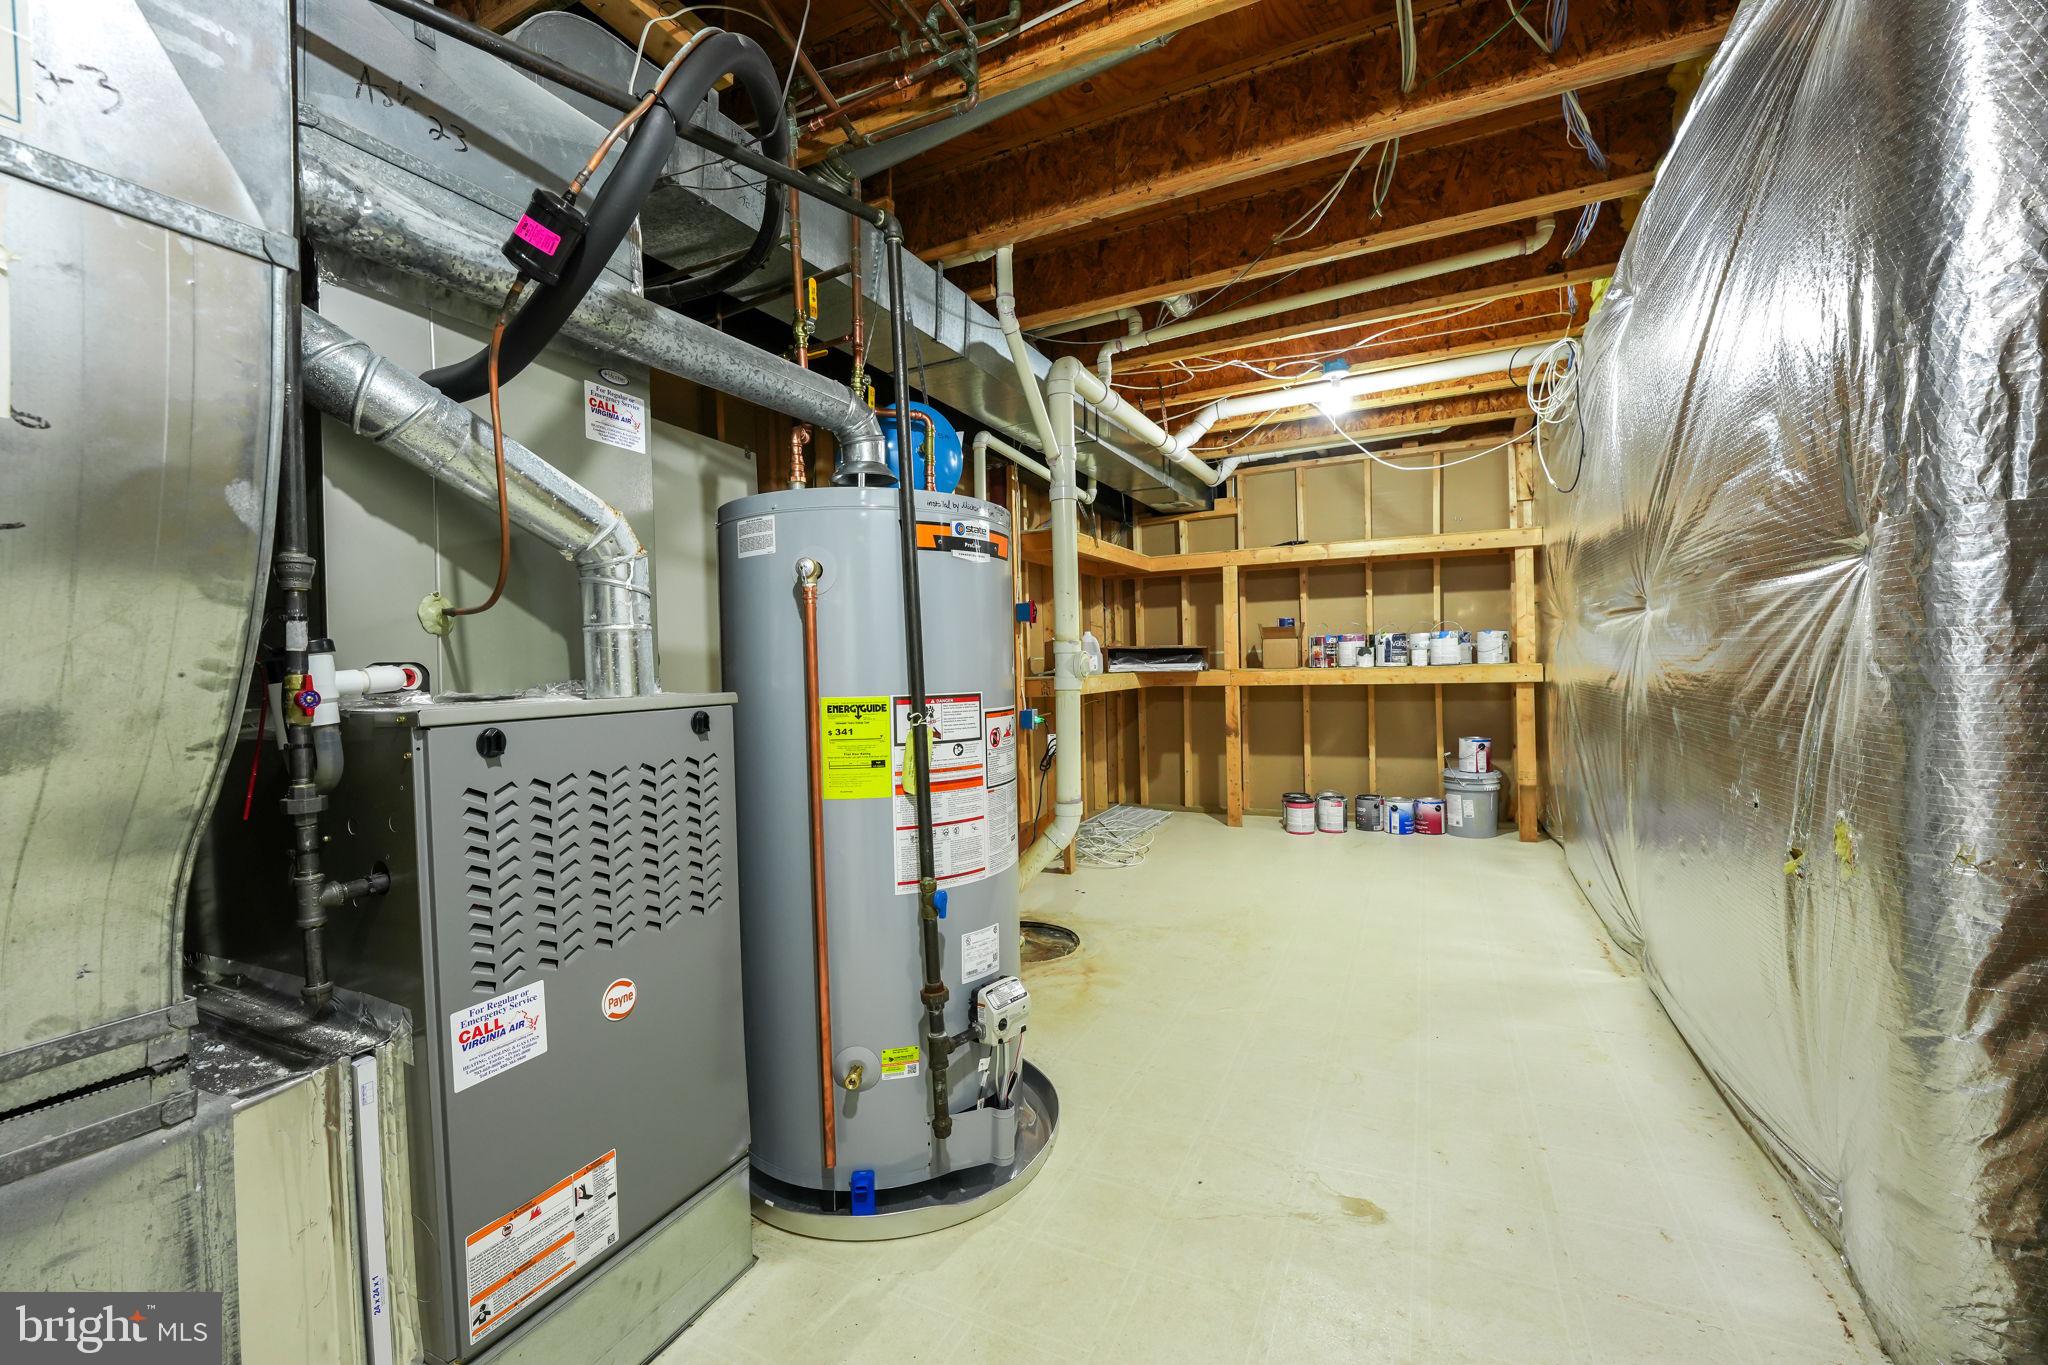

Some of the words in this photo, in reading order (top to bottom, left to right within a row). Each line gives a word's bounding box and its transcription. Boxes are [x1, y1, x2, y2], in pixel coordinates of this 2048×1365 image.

[590, 389, 620, 406] Emergency
[621, 401, 640, 411] Service
[595, 386, 606, 394] For
[607, 389, 628, 402] Regular
[588, 397, 618, 414] CALL
[590, 407, 619, 421] VIRGINIA
[620, 416, 632, 424] AIR
[965, 525, 987, 536] state
[827, 704, 887, 715] ENERGYGUIDE
[469, 1006, 484, 1018] For
[487, 993, 519, 1011] Regular
[520, 989, 530, 997] or
[608, 991, 634, 1009] Payne
[460, 1007, 506, 1030] Emergency
[509, 994, 538, 1011] Service
[458, 1018, 504, 1044] CALL
[461, 1029, 506, 1052] VIRGINIA
[508, 1019, 525, 1033] AIR
